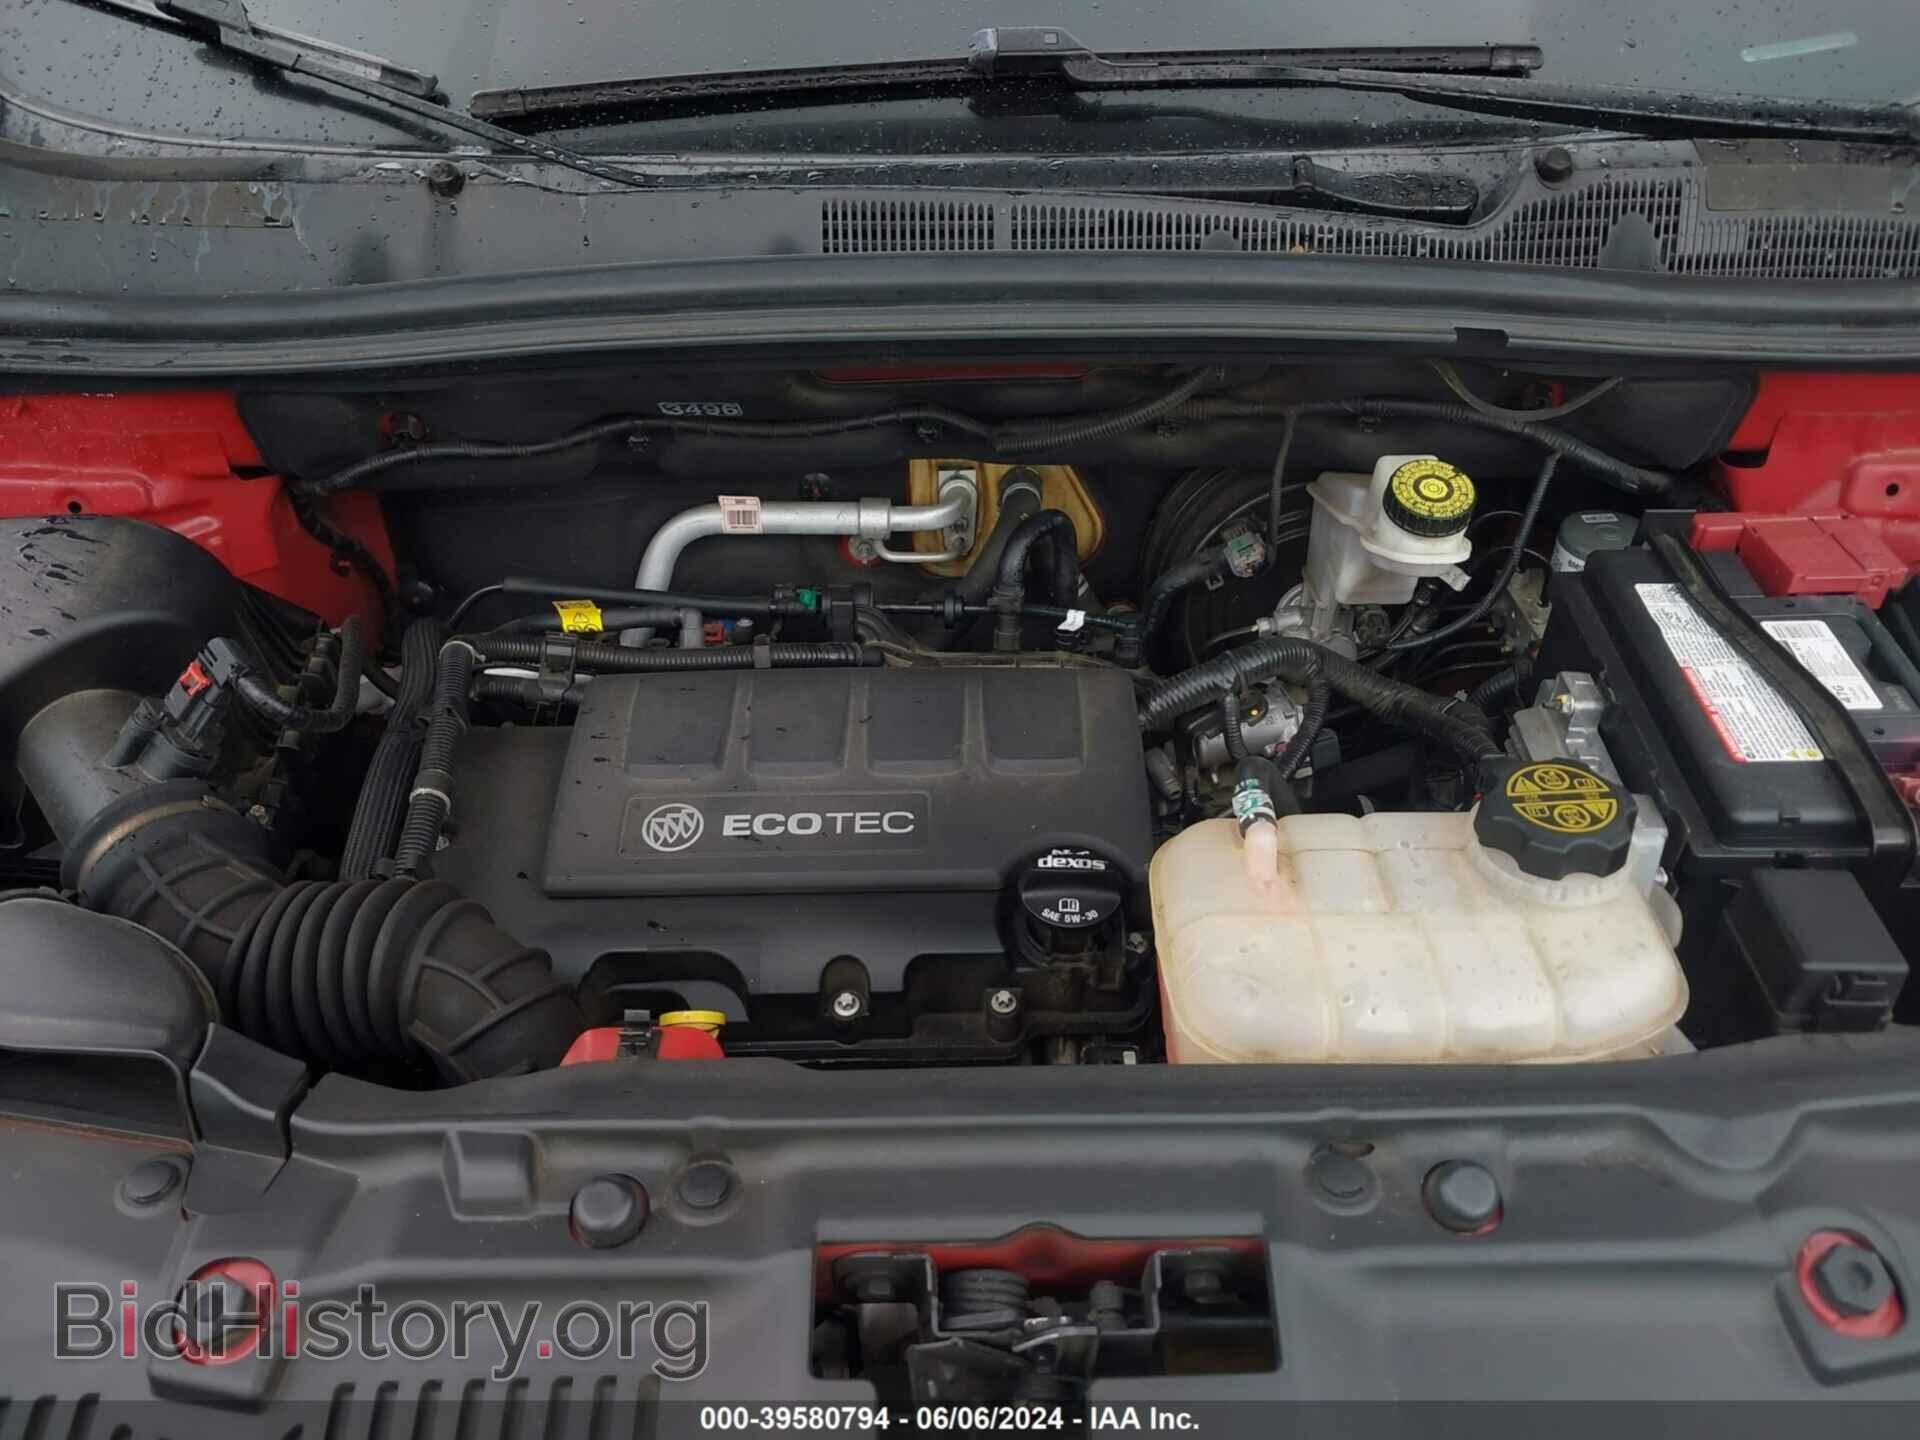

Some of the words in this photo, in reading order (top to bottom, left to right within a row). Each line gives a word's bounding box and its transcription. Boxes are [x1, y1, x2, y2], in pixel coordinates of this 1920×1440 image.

[722, 811, 915, 836] ECOTEC
[1038, 855, 1105, 870] dexos
[1041, 908, 1060, 922] SAE
